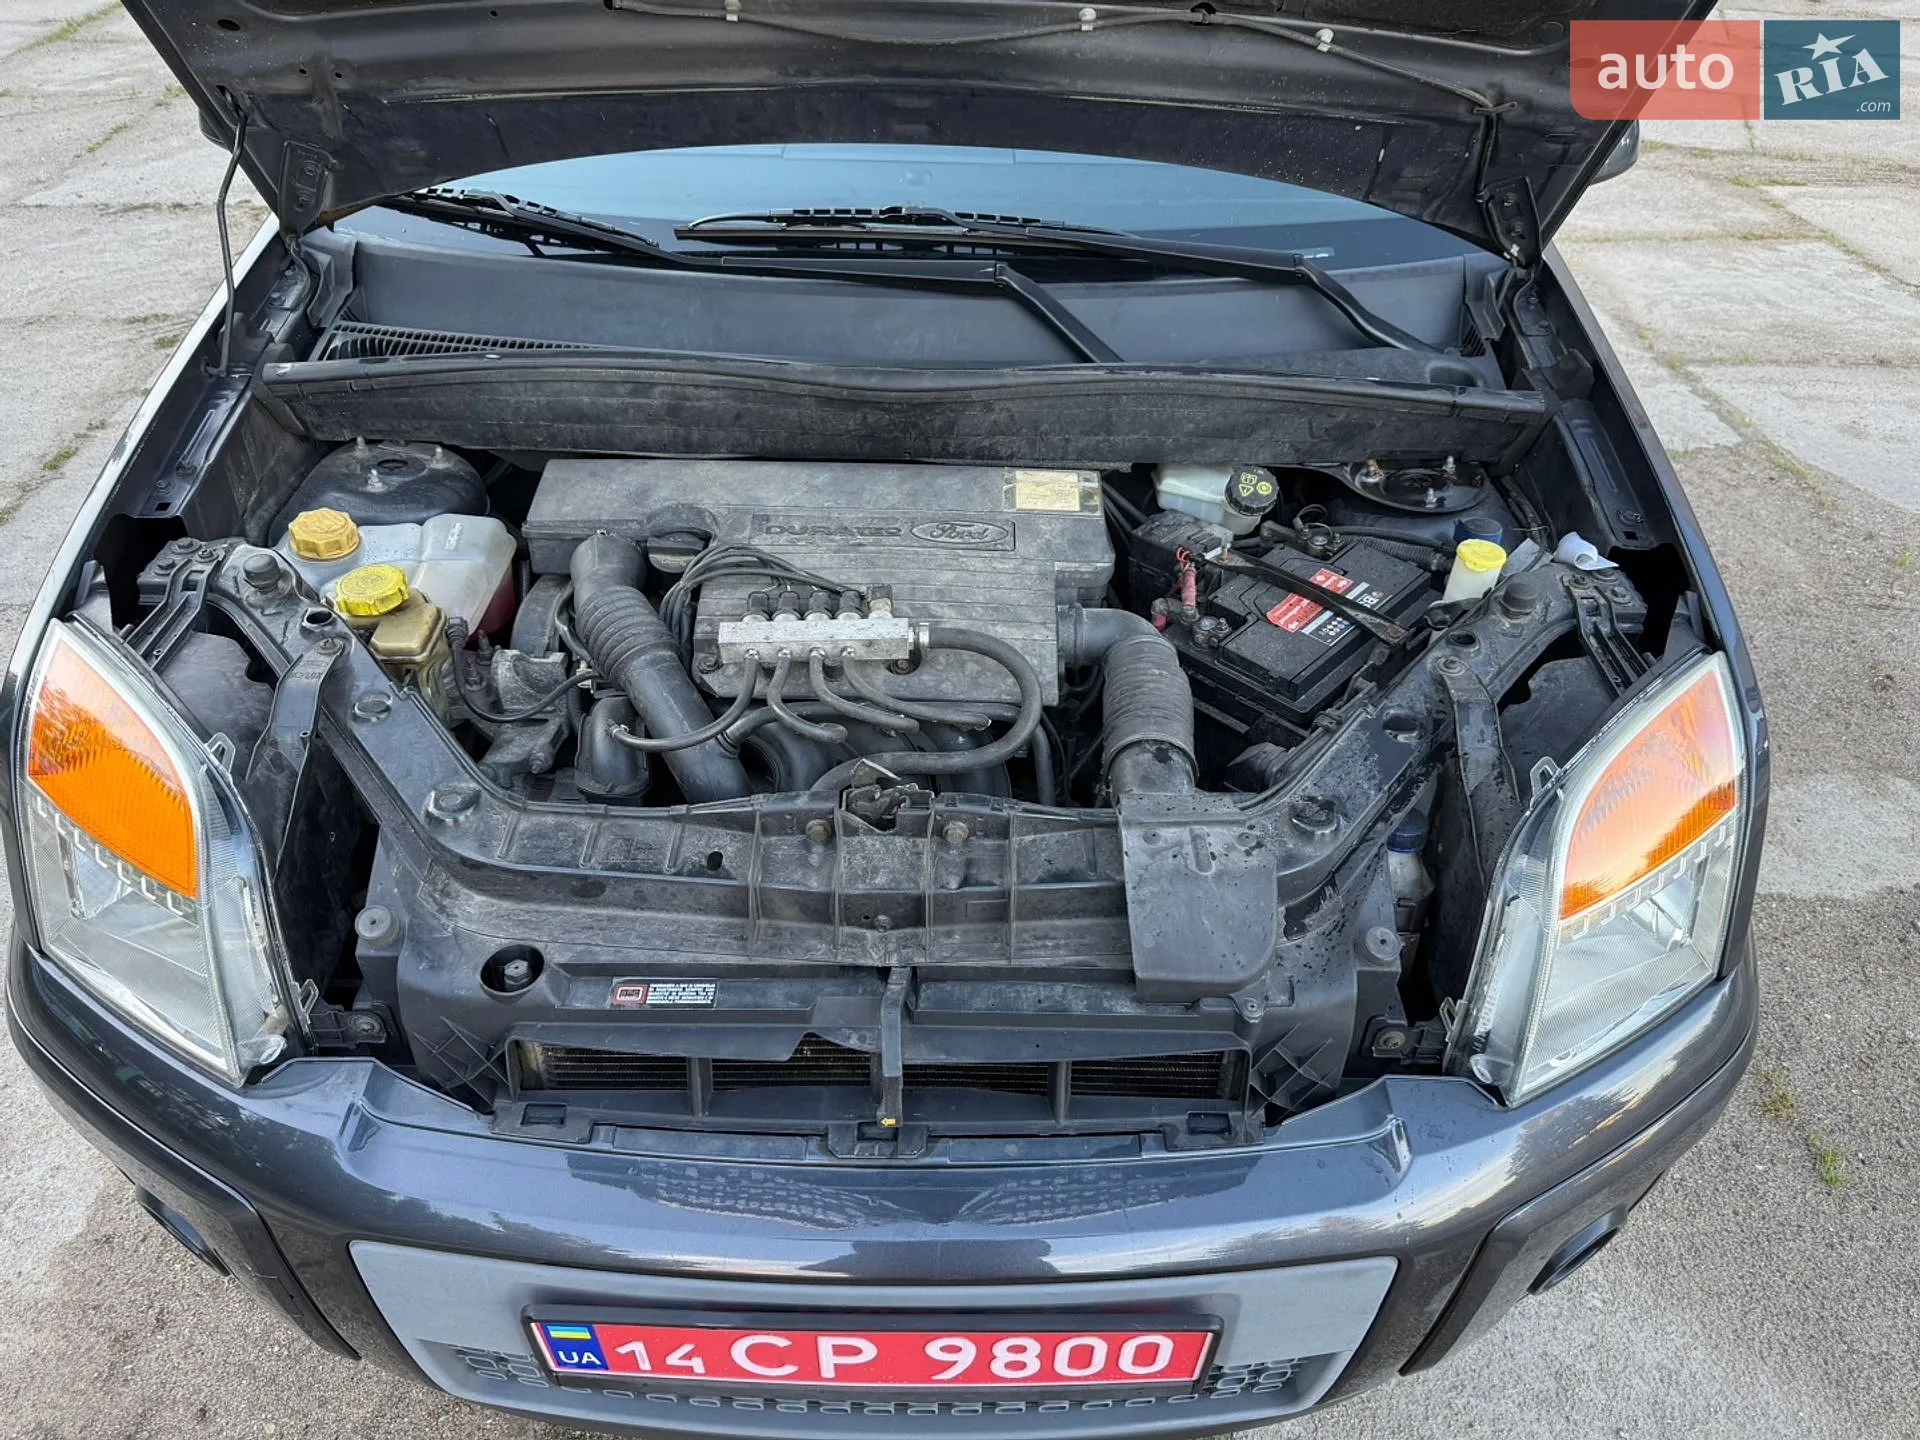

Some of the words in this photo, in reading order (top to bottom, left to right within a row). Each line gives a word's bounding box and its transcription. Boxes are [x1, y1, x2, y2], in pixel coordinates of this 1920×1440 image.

[929, 522, 990, 540] Ford
[557, 1350, 601, 1365] UA
[615, 1341, 706, 1374] 14
[730, 1334, 878, 1379] CP
[924, 1335, 1174, 1380] 9800
